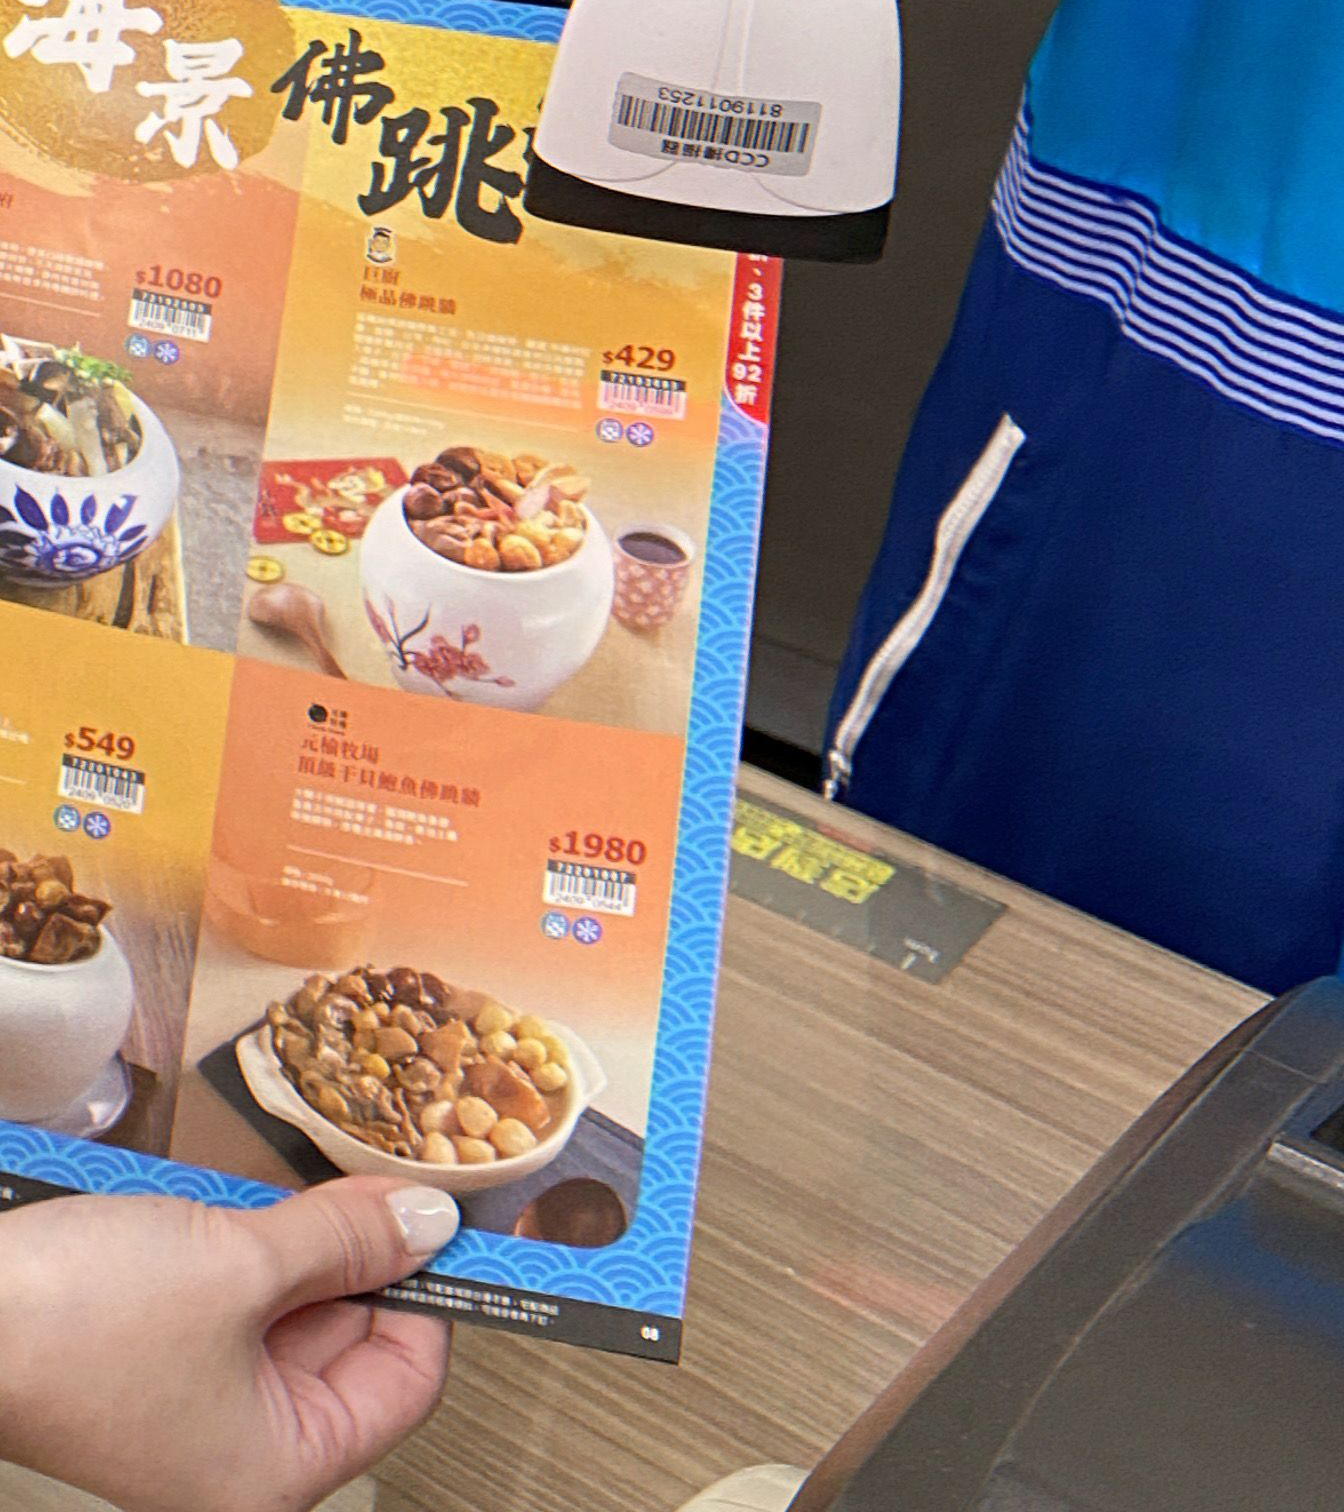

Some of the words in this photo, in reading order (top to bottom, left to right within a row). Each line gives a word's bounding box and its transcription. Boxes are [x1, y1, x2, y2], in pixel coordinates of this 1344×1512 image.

[657, 86, 784, 118] 8119011253
[134, 264, 223, 299] $1080
[601, 344, 676, 372] $429
[64, 726, 136, 760] $549
[548, 830, 647, 866] $1980
